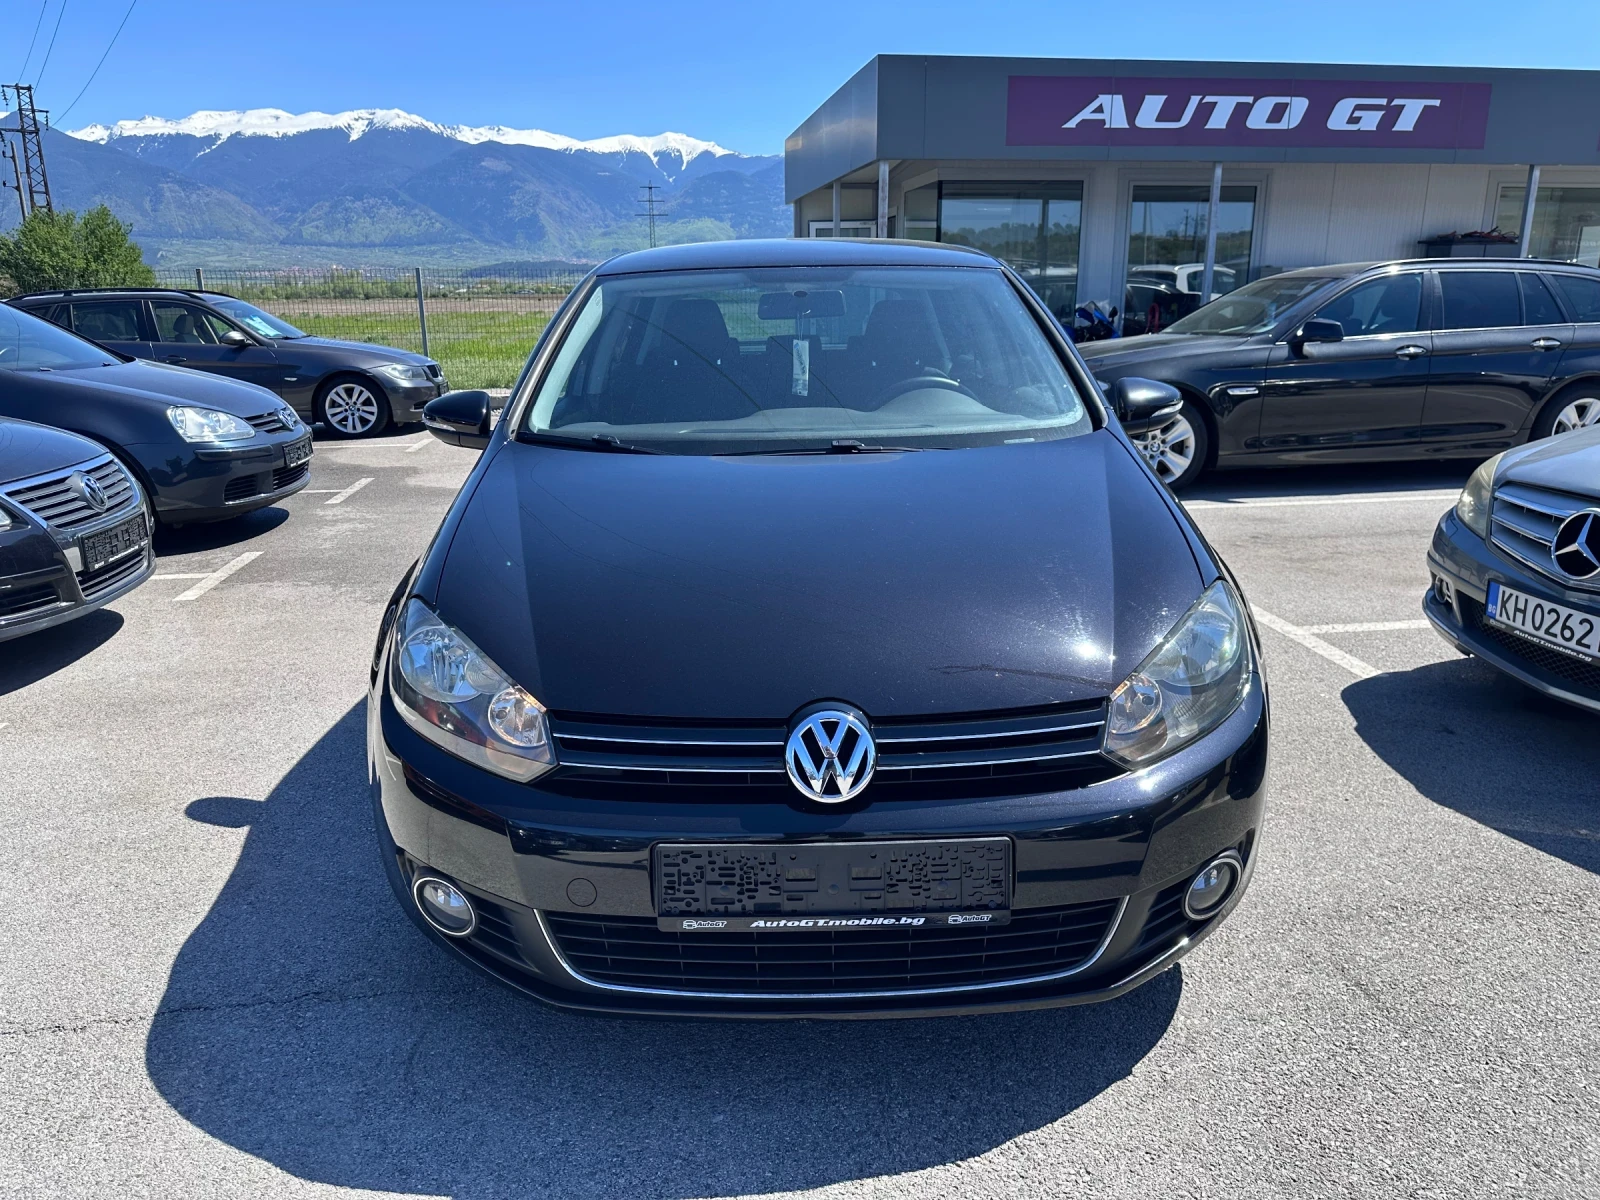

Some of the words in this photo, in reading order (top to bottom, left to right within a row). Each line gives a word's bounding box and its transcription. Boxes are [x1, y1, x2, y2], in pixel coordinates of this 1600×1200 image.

[1061, 93, 1310, 130] AUTO
[1326, 97, 1441, 132] GT
[1487, 603, 1496, 614] BG
[1499, 590, 1600, 653] KH0262
[785, 710, 876, 804] VW
[696, 920, 728, 928] AutoGT
[961, 914, 992, 923] AutoGT
